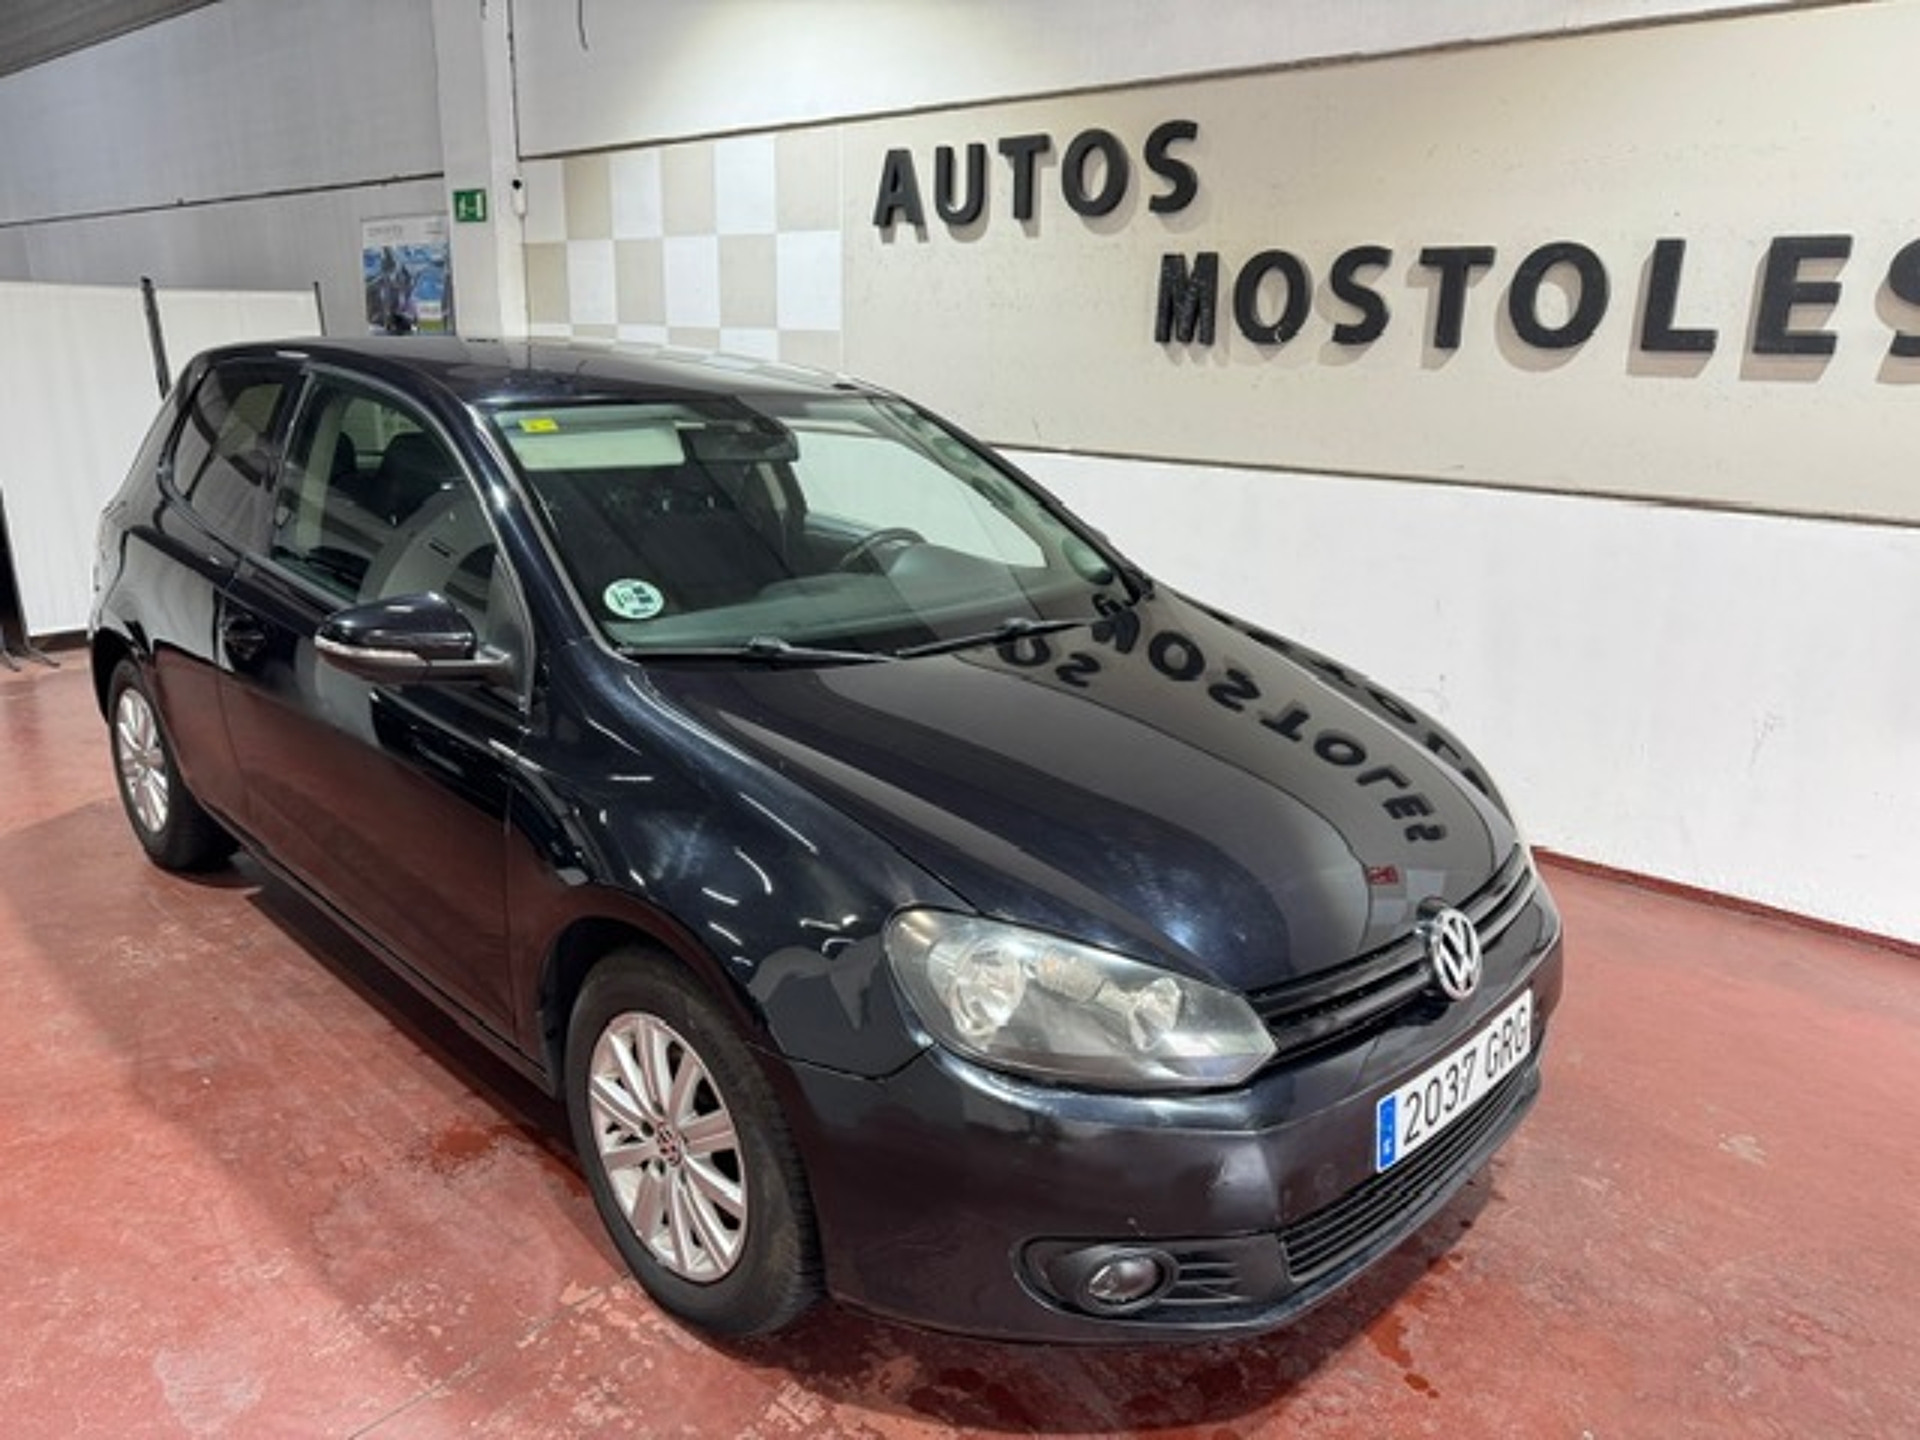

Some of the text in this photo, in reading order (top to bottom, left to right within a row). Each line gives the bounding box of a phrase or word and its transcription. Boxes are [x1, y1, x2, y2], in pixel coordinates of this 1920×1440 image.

[873, 119, 1199, 227] AUTOS
[1403, 1005, 1527, 1147] 2037 GRG
